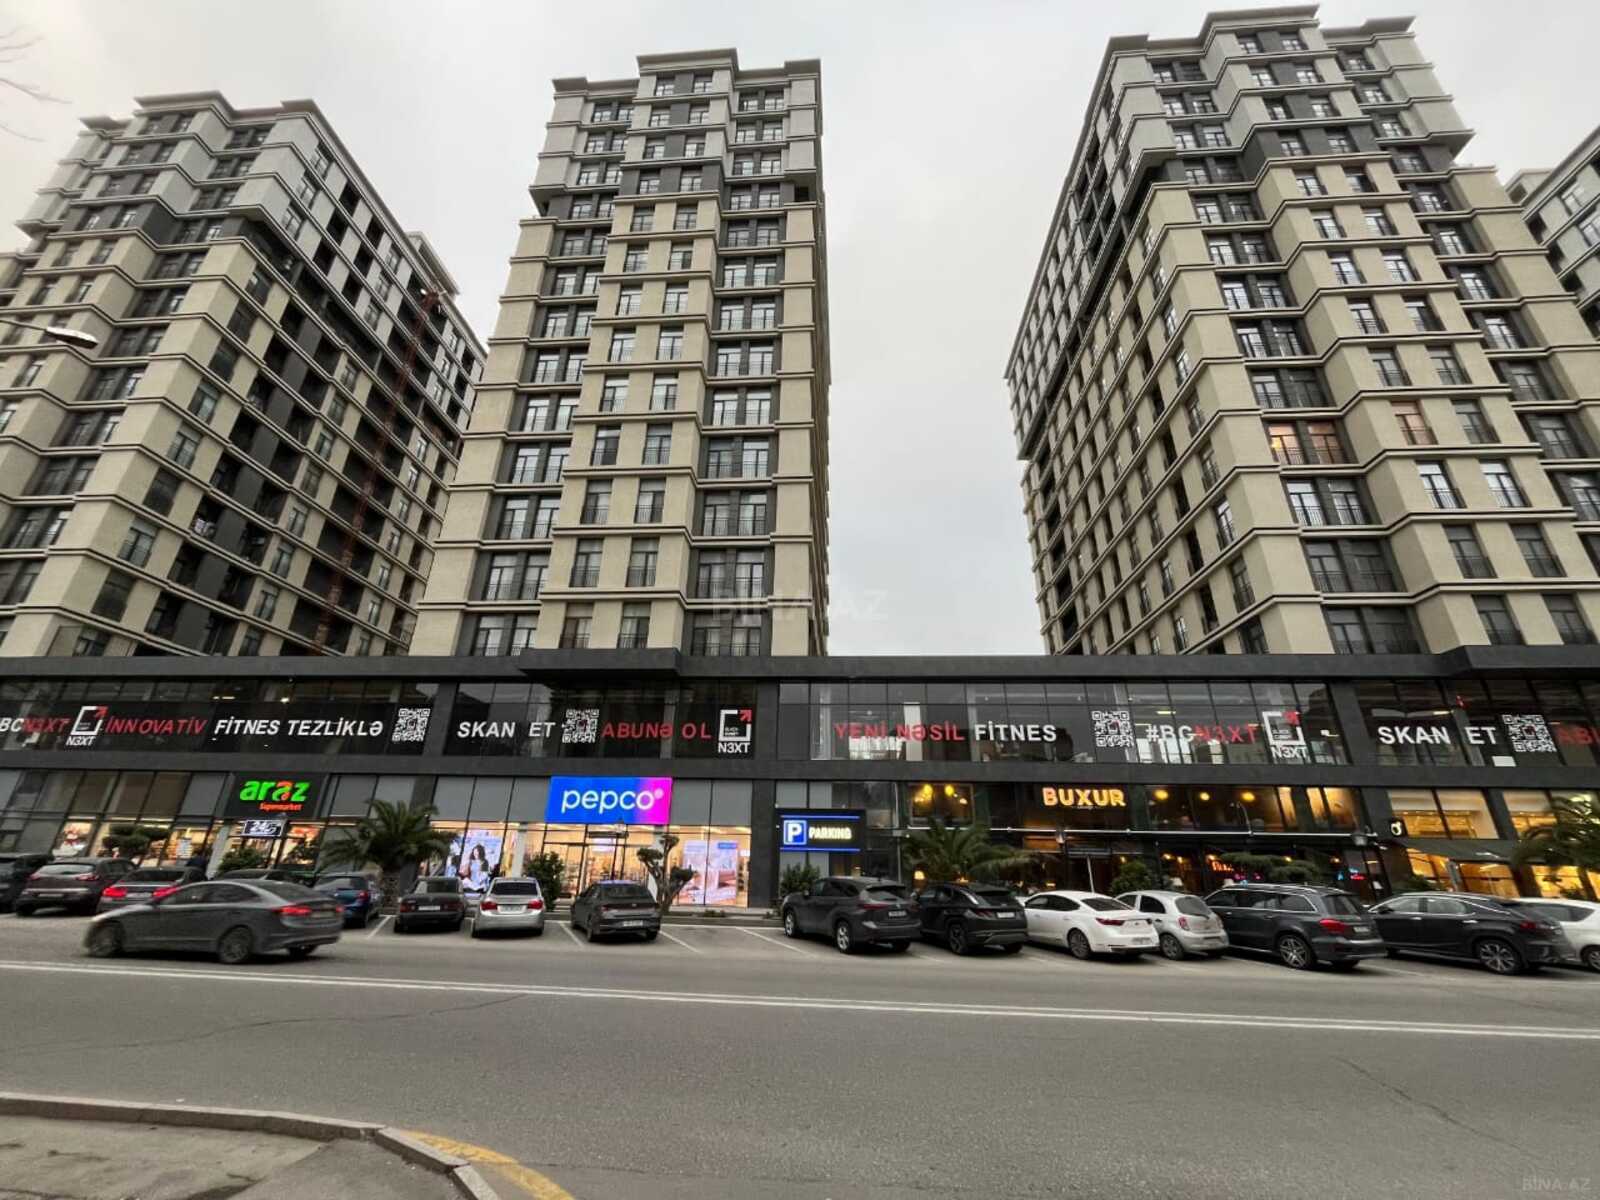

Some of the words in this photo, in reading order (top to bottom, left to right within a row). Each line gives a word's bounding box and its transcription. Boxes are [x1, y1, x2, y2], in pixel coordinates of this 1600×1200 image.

[214, 716, 281, 735] FİTNES
[288, 717, 384, 737] TEZLİKLƏ
[457, 721, 515, 739] SKAN
[529, 721, 556, 739] ET
[602, 721, 673, 740] ABUNƏ
[834, 720, 887, 741] YENİ
[974, 720, 1057, 743] FİTNES
[1378, 725, 1451, 746] SKAN
[1466, 726, 1497, 745] ET
[65, 735, 96, 747] N3XT
[718, 742, 751, 754] N3XT
[1271, 746, 1308, 759] N3XT
[239, 780, 311, 802] araz
[561, 788, 655, 814] pepco
[1042, 787, 1126, 807] BUXUR
[787, 823, 803, 843] P
[808, 826, 852, 840] PARKING
